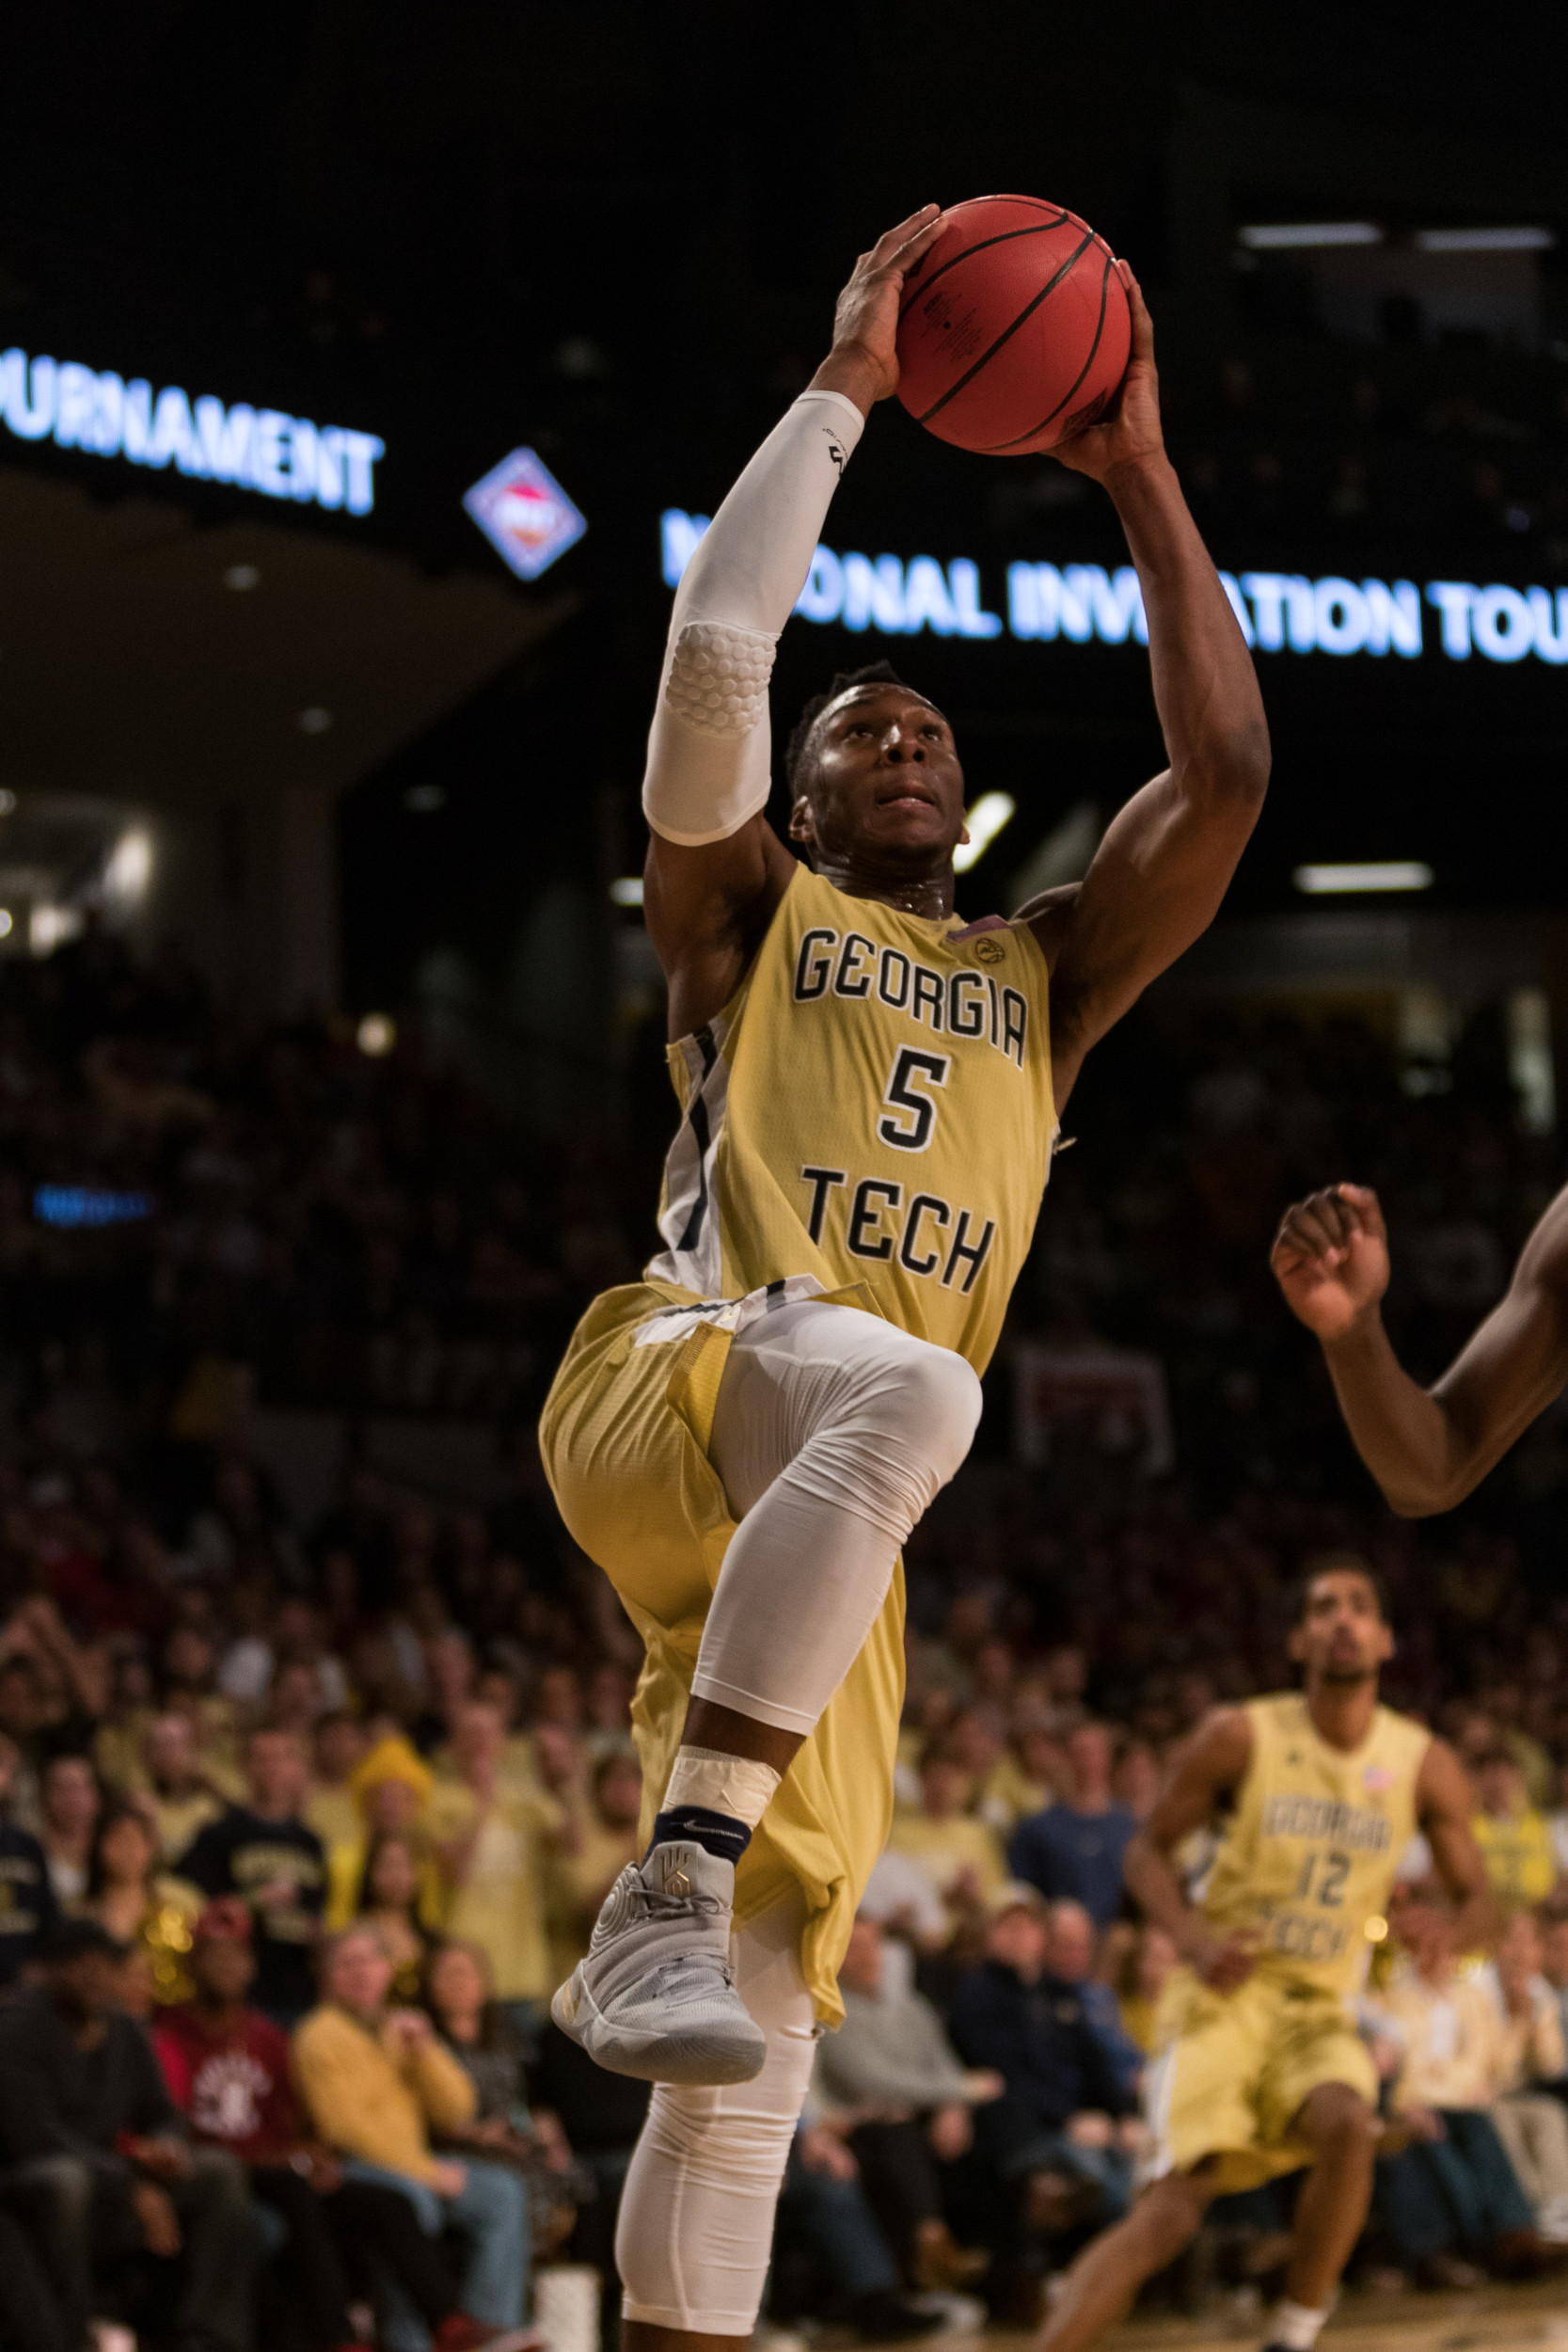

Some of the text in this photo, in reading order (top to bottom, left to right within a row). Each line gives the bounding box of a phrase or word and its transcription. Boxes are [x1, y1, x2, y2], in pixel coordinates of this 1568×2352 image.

[0, 347, 385, 516] URNAMENT
[792, 928, 1028, 1073] GEORGIA
[877, 1043, 951, 1153] 5
[800, 1165, 995, 1296] TECH
[1296, 1850, 1352, 1909] 12
